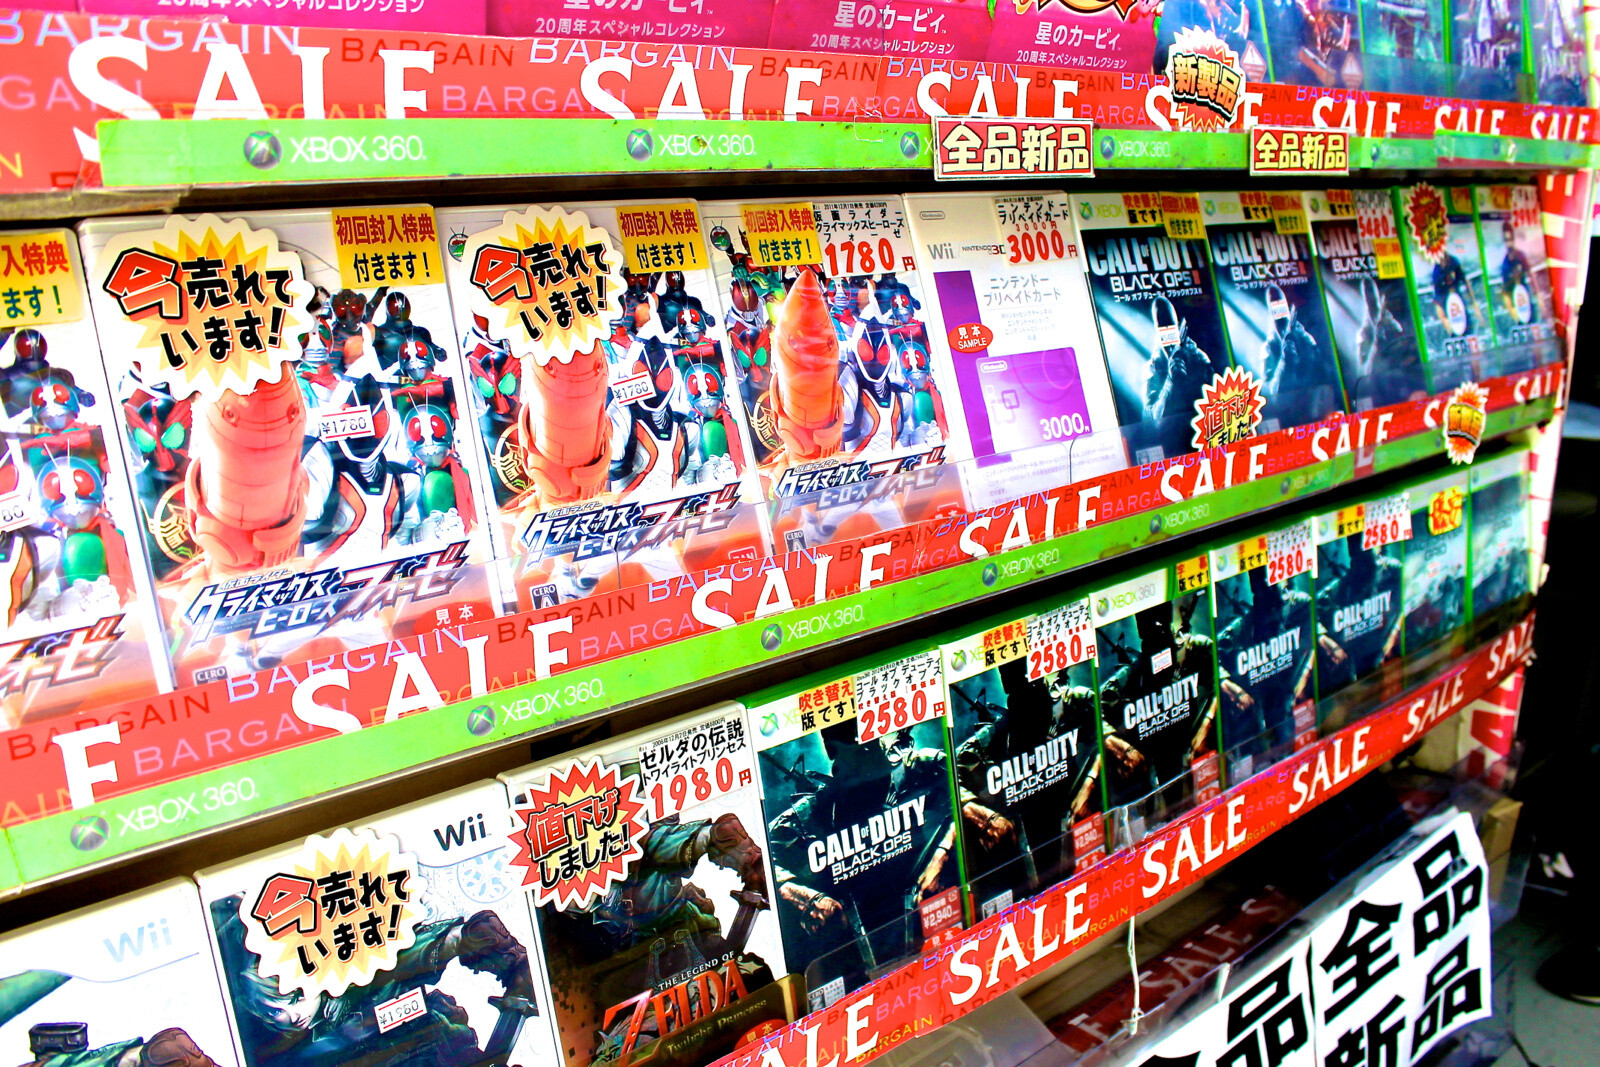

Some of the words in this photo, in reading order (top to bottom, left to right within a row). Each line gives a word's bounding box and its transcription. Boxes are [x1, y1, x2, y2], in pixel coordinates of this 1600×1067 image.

[535, 17, 726, 40] 20周年スペシャルコレクション
[834, 0, 944, 34] 星のカービィ
[1035, 20, 1120, 50] 星のカービィ
[1171, 52, 1241, 115] 新製品
[291, 136, 367, 163] XBOX
[372, 134, 424, 161] 360
[660, 135, 716, 156] XBOX
[718, 134, 754, 156] 360
[942, 122, 1090, 173] 全品新品
[1254, 131, 1347, 172] 全品新品
[336, 211, 435, 246] 初回封入特典
[619, 210, 699, 239] 初回封入特典
[743, 209, 815, 233] 初回封入特典
[353, 250, 431, 283] 付きます!
[635, 240, 697, 270] 付きます!
[927, 242, 955, 261] Wii
[1089, 236, 1149, 276] CALL
[1212, 232, 1262, 267] CALL
[1332, 256, 1369, 273] BLACK
[990, 273, 1050, 290] ニンテンドー
[1109, 273, 1163, 293] BLACK
[1164, 271, 1192, 287] OPS
[1231, 264, 1274, 283] BLACK
[1274, 261, 1298, 277] OPS
[518, 275, 608, 342] います!
[160, 306, 288, 370] います!
[957, 324, 982, 340] 見本
[957, 337, 987, 350] SAMPLE
[1164, 511, 1192, 528] XBOX
[1191, 502, 1210, 520] 360
[1001, 557, 1036, 579] XBOX
[1036, 548, 1060, 568] 360
[532, 583, 556, 597] CERO
[1111, 592, 1138, 611] XBOX
[1138, 582, 1157, 600] 360
[435, 604, 474, 626] 見本
[787, 613, 830, 642] XBOX
[831, 604, 863, 628] 360
[1333, 602, 1364, 633] CALL
[1363, 590, 1393, 619] DUTY
[983, 620, 1027, 649] 吹き替え
[985, 637, 1029, 667] 版です!
[1236, 640, 1269, 677] CALL
[1270, 626, 1302, 662] DUTY
[196, 668, 226, 682] CERO
[856, 675, 879, 692] コール
[881, 667, 897, 682] オブ
[901, 656, 941, 676] デューティ
[1249, 662, 1277, 681] BLACK
[1277, 652, 1293, 671] OPS
[501, 689, 559, 725] XBOX
[564, 678, 604, 706] 360
[798, 679, 854, 713] 吹き替え
[801, 696, 857, 732] 版です!
[1124, 691, 1160, 730] CALL
[1162, 672, 1200, 710] DUTY
[1401, 667, 1468, 743] SALE
[1138, 709, 1170, 734] BLACK
[1171, 700, 1191, 718] OPS
[641, 717, 745, 770] ゼルダの伝説
[643, 737, 747, 787] トワイライトプリンセス
[986, 751, 1030, 796] CALL
[1034, 728, 1079, 773] DUTY
[1005, 772, 1043, 799] BLACK
[1045, 760, 1068, 779] OPS
[1288, 725, 1372, 815] SALE
[117, 792, 196, 837] XBOX
[203, 777, 255, 812] 360
[525, 787, 621, 862] 値下げ
[433, 812, 487, 852] Wii
[807, 821, 868, 874] CALL
[861, 825, 870, 839] OF
[868, 794, 927, 845] DUTY
[1142, 794, 1248, 899] SALE
[540, 824, 630, 890] しました!
[832, 842, 881, 877] BLACK
[882, 830, 913, 852] OPS
[833, 872, 850, 885] コール
[102, 917, 173, 963] Wii
[296, 904, 405, 976] います!
[949, 882, 1091, 1006] SALE
[657, 977, 678, 992] THE
[680, 957, 719, 982] LEGEND
[722, 950, 735, 963] OF
[602, 959, 749, 1065] ZELDA
